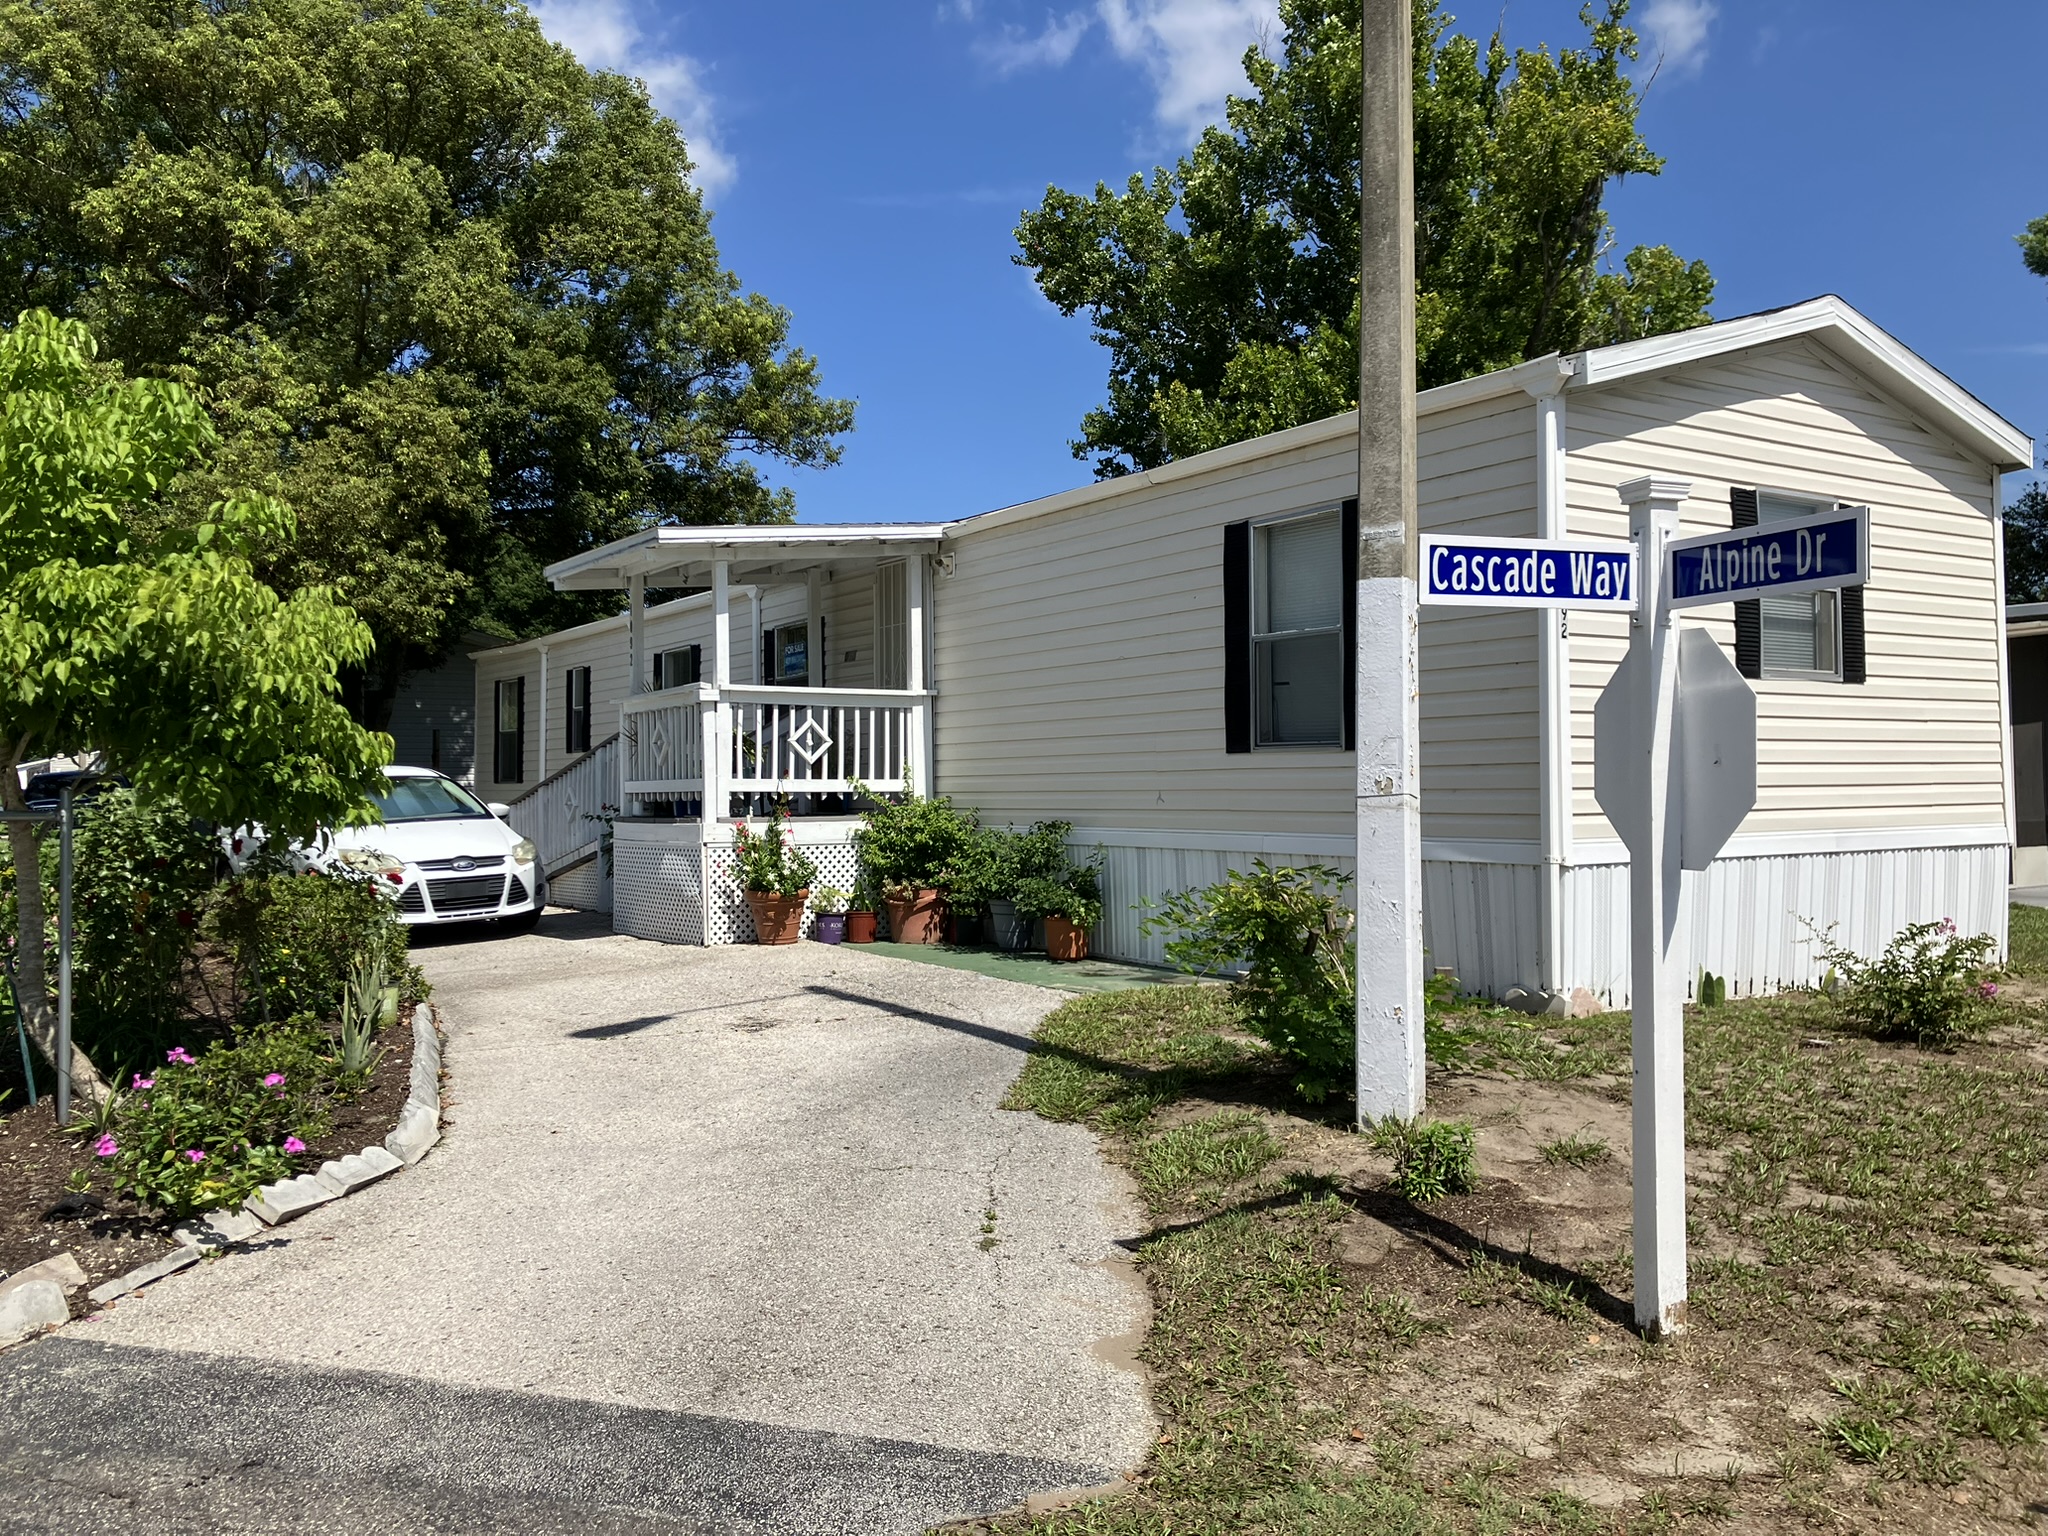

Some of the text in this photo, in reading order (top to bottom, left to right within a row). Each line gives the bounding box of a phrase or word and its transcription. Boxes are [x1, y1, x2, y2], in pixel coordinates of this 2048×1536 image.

[1432, 546, 1628, 600] Cascade Way
[1699, 528, 1827, 591] Alpine Dr
[785, 642, 804, 655] FOR SALE
